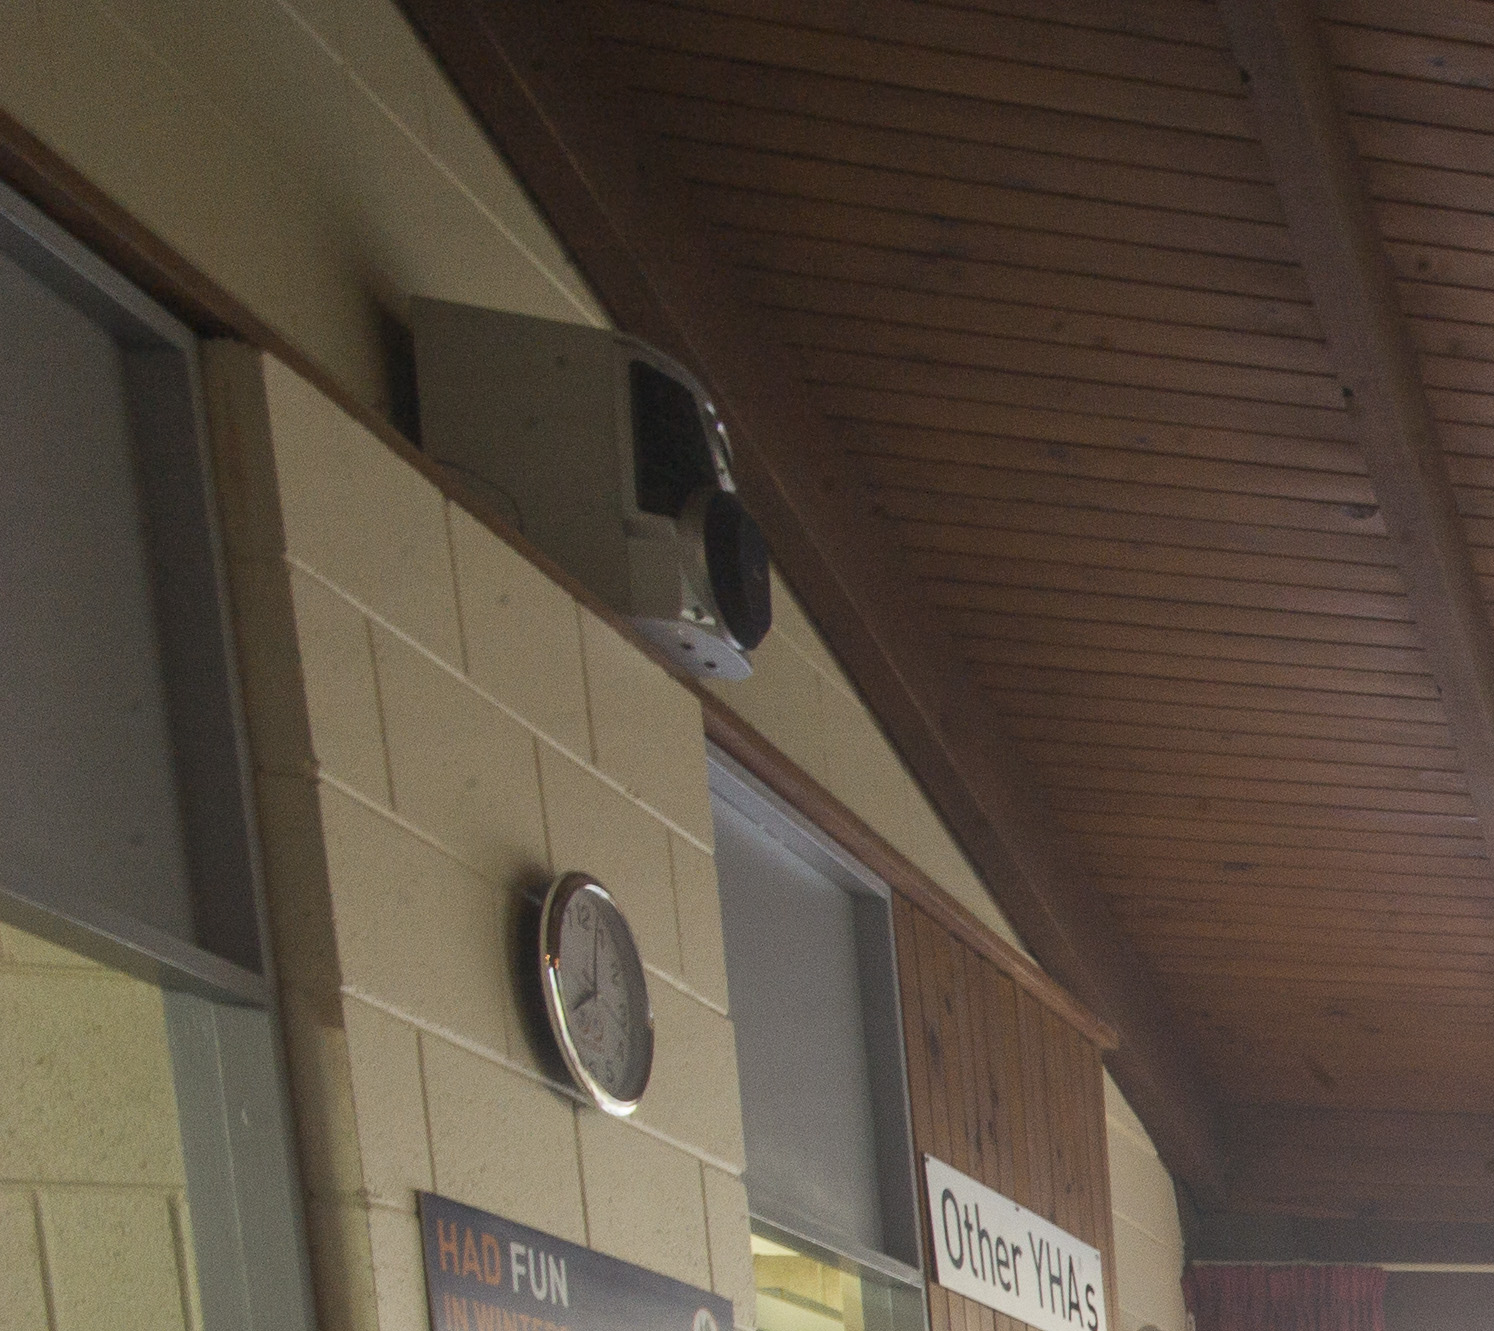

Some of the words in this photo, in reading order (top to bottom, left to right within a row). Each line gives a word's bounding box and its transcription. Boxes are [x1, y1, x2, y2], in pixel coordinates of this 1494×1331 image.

[437, 1219, 501, 1287] HAD
[509, 1241, 569, 1308] FUN
[941, 1187, 1022, 1298] Other
